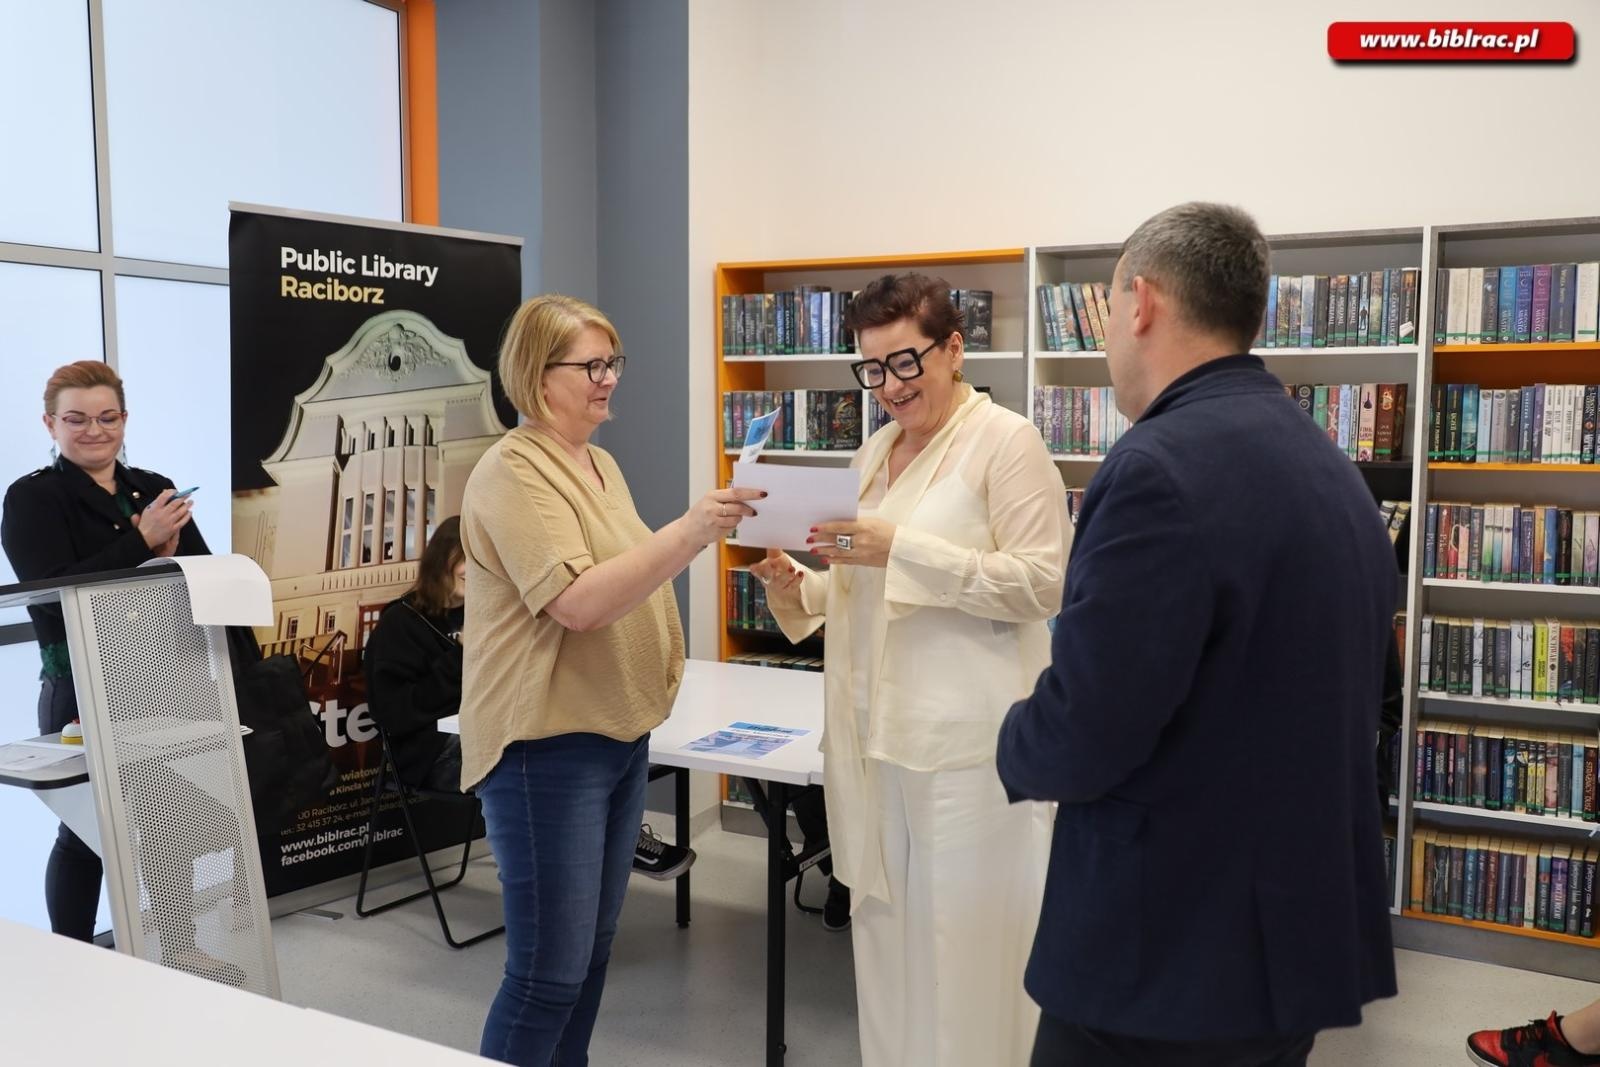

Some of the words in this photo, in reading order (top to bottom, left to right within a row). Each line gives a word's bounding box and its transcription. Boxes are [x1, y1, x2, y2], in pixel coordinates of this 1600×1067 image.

[280, 247, 356, 275] Public
[361, 254, 439, 288] Library
[280, 276, 385, 304] Raciborz
[1328, 294, 1336, 325] ANGELFALL
[1426, 532, 1435, 552] Pike
[1439, 533, 1448, 553] Pike
[341, 767, 379, 781] wiatow
[280, 822, 370, 854] www.biblrac.pl
